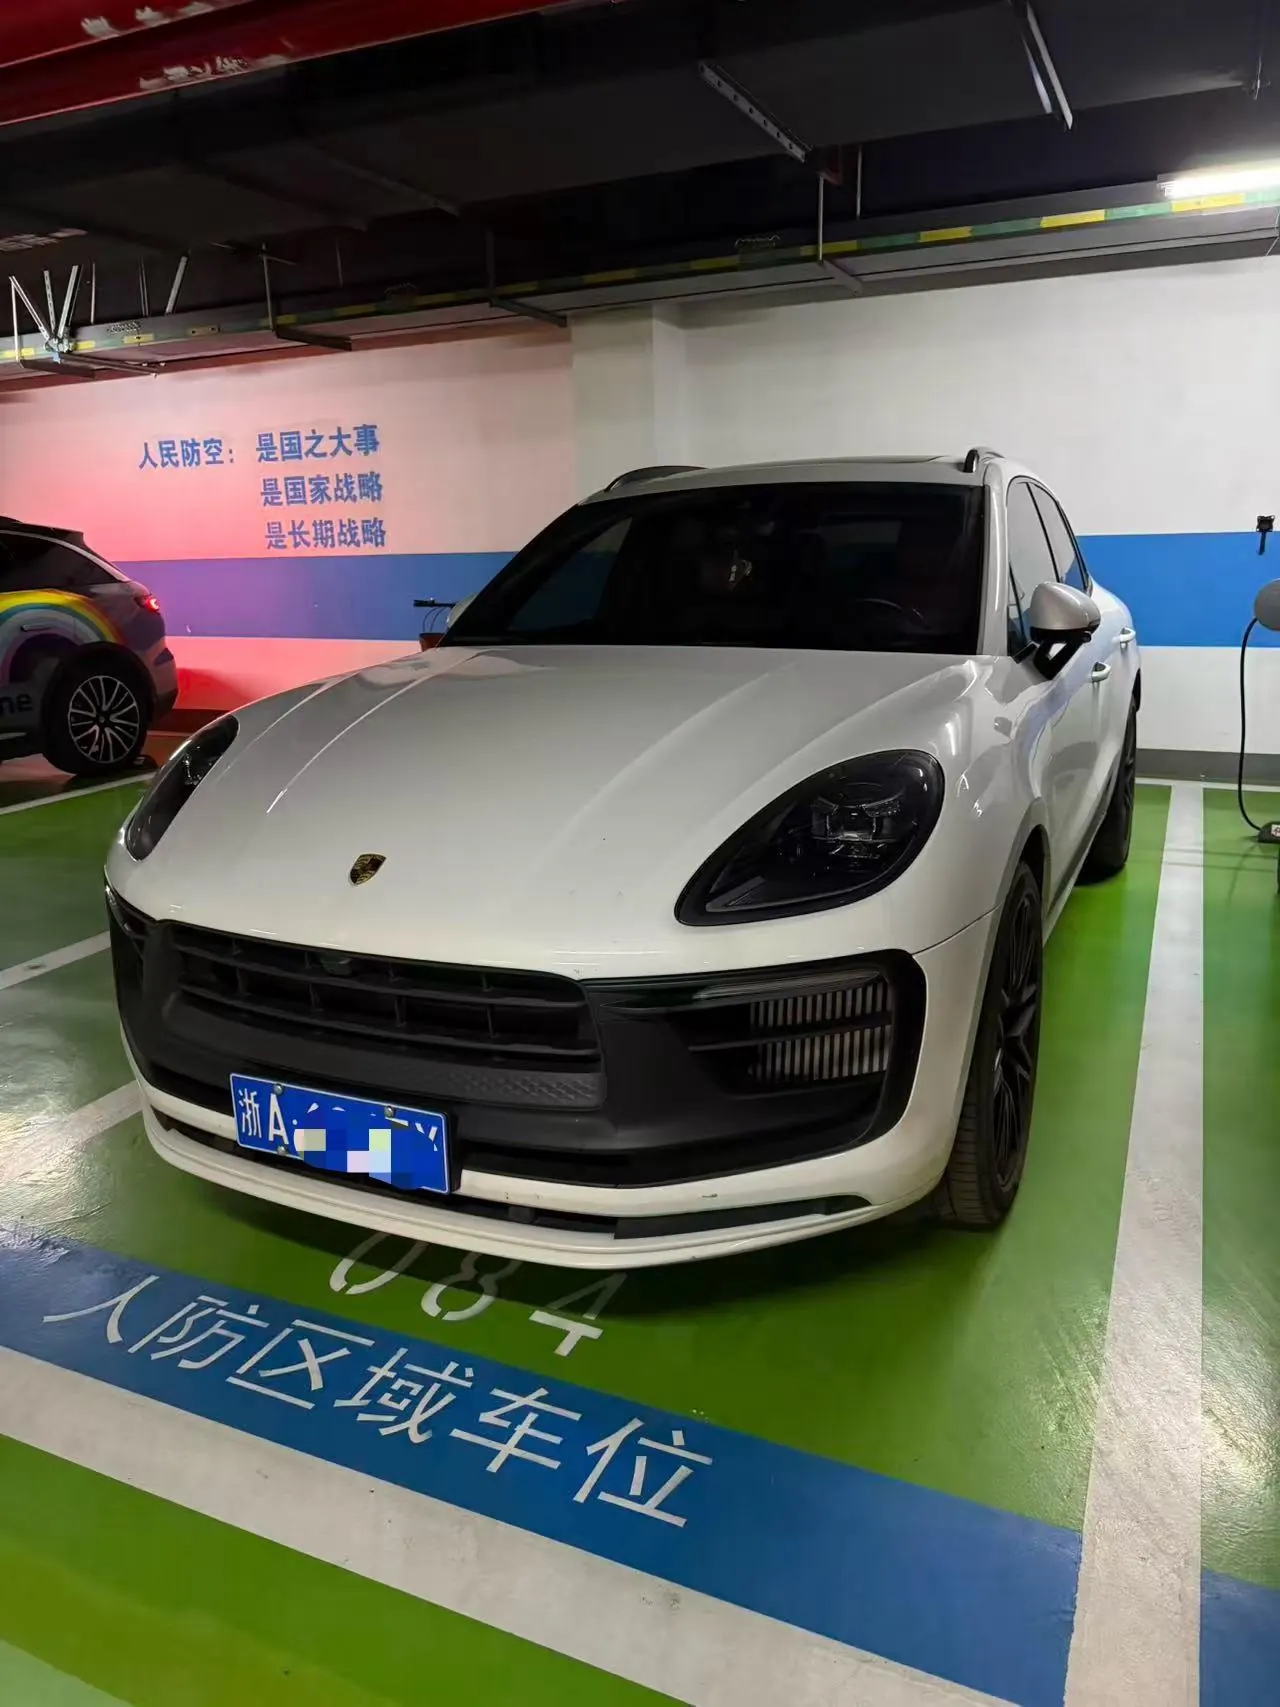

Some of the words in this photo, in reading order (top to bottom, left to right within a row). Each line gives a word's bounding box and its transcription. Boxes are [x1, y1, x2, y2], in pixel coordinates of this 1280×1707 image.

[138, 437, 235, 470] 人民防空：
[255, 423, 380, 463] 是国之大事
[260, 470, 383, 507] 是国家战略
[264, 516, 387, 550] 是长期战略
[329, 1231, 628, 1357] 084
[42, 1274, 713, 1528] 人防区域车位
